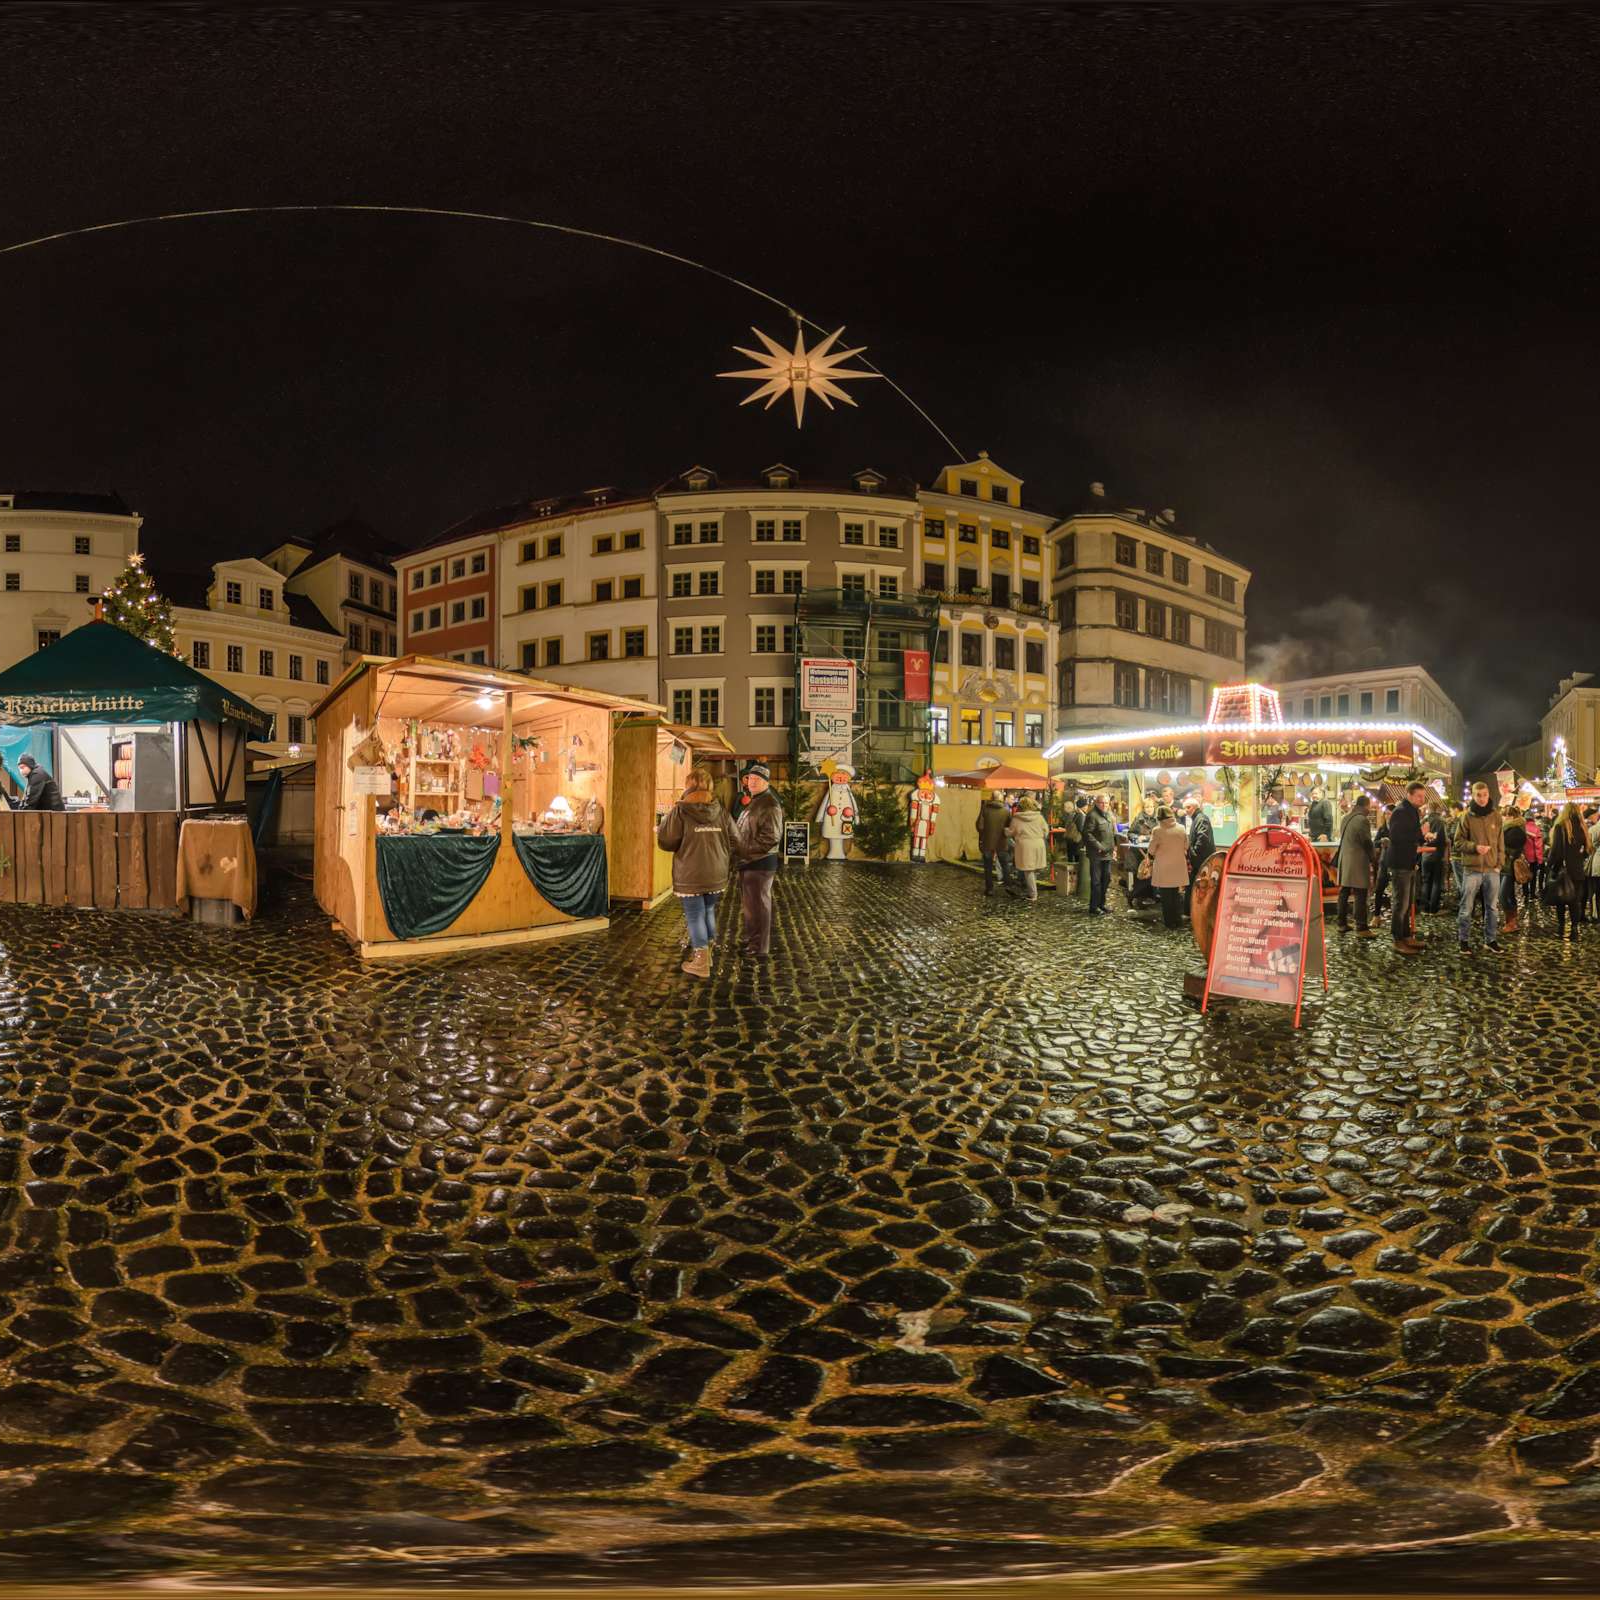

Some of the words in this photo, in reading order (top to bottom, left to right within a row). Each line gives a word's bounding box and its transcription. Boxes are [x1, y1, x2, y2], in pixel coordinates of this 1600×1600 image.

[3, 695, 145, 715] Räucherhütte
[1220, 740, 1290, 759] Thiemes
[1295, 740, 1398, 760] Schwenkgrill
[1078, 749, 1135, 766] Grillbratwurst
[1237, 864, 1303, 875] Holzkohle-Grill
[1235, 886, 1263, 896] Original
[1264, 888, 1297, 898] Thüringer
[1234, 895, 1283, 906] Rostbratwurst
[1255, 908, 1299, 919] Fleischspieß
[1231, 914, 1250, 924] Steak
[1251, 917, 1263, 926] mit
[1263, 918, 1295, 929] Zwiebeln
[1230, 925, 1261, 935] Krakauer
[1228, 934, 1269, 946] Curry-Wurst
[1227, 943, 1263, 955] Bockwurst
